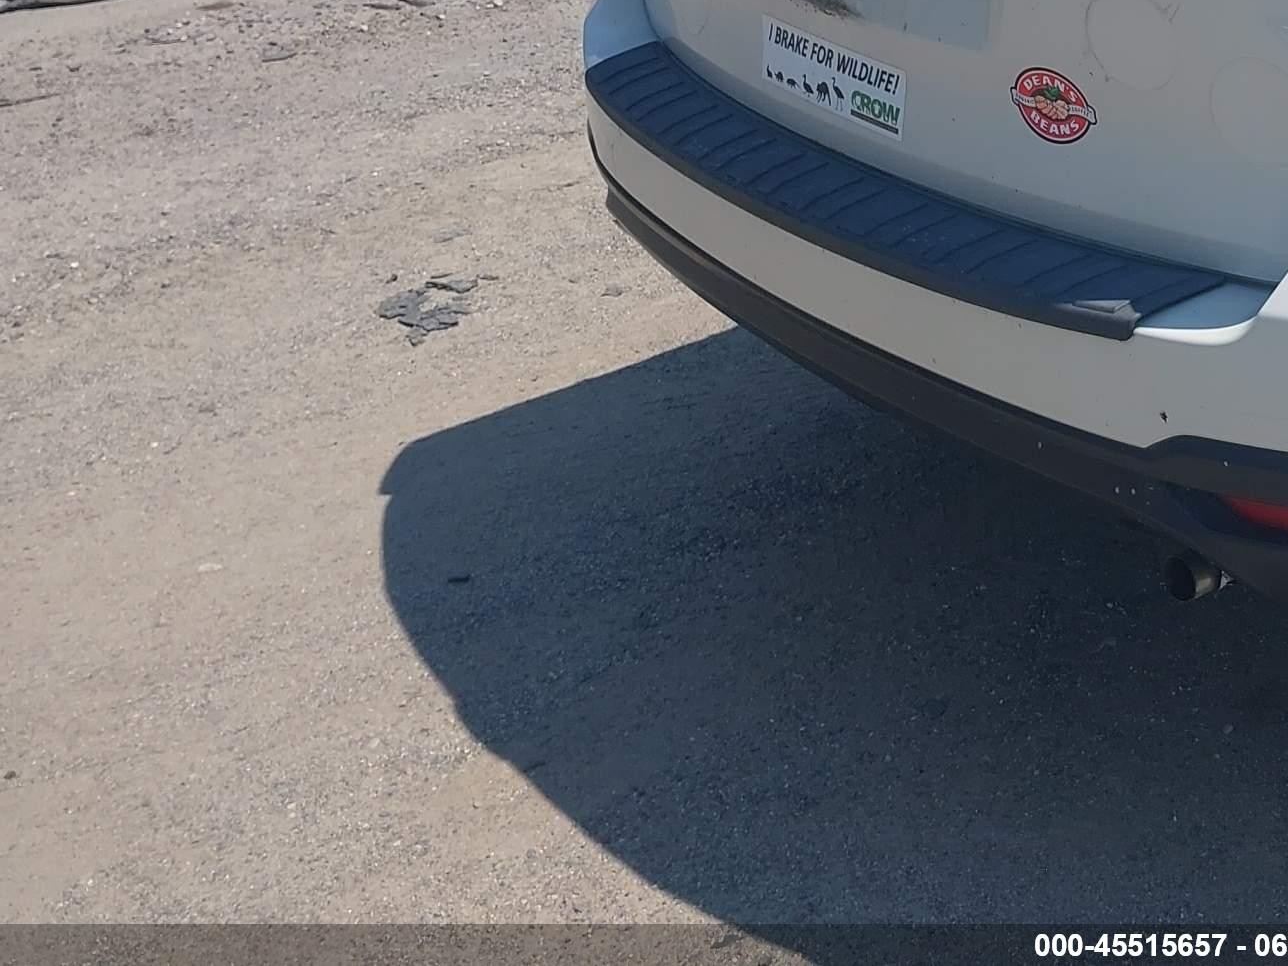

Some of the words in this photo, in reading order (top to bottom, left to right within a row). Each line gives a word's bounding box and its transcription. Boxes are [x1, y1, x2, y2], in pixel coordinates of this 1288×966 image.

[768, 23, 774, 42] I
[774, 26, 809, 58] BRAKE
[810, 43, 834, 68] FOR
[836, 52, 900, 95] WILDLIFE!
[1023, 75, 1078, 103] DEAN'S
[851, 90, 901, 126] CROW
[1030, 110, 1080, 135] BEANS
